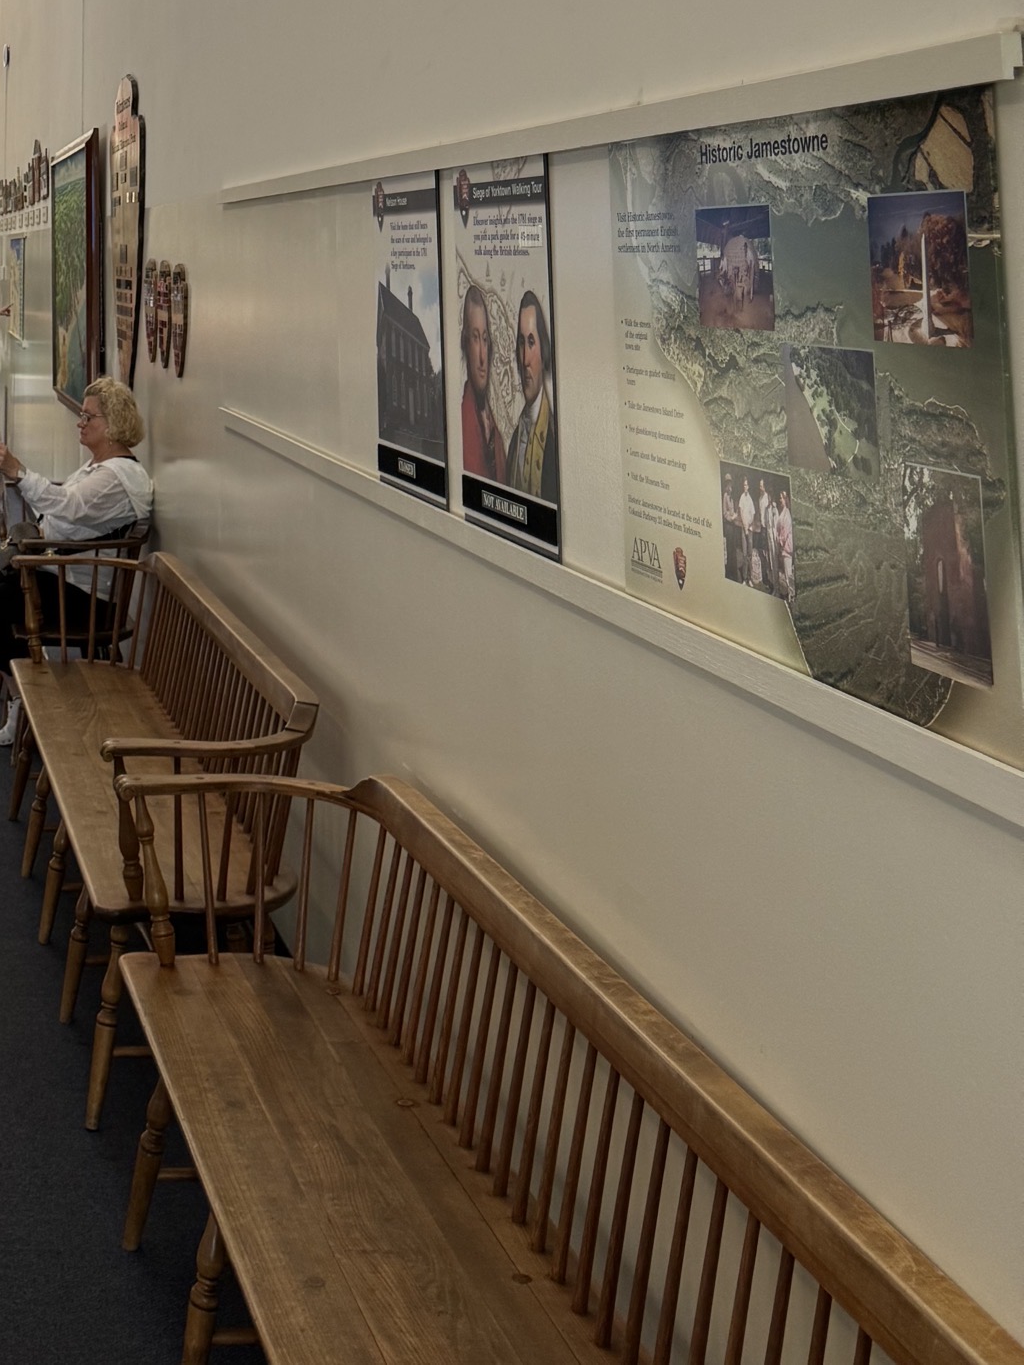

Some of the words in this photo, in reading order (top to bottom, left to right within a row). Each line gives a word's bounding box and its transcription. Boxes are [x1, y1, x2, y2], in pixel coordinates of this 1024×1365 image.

[699, 140, 743, 164] Historic
[747, 134, 828, 160] Jamestowne
[473, 187, 485, 201] Siege
[486, 186, 491, 198] of
[491, 186, 511, 197] Yorktown
[511, 183, 531, 197] Walking
[531, 181, 542, 194] Tour
[483, 494, 494, 507] NOT
[495, 498, 524, 520] AVAILABLE
[632, 536, 662, 569] APVA
